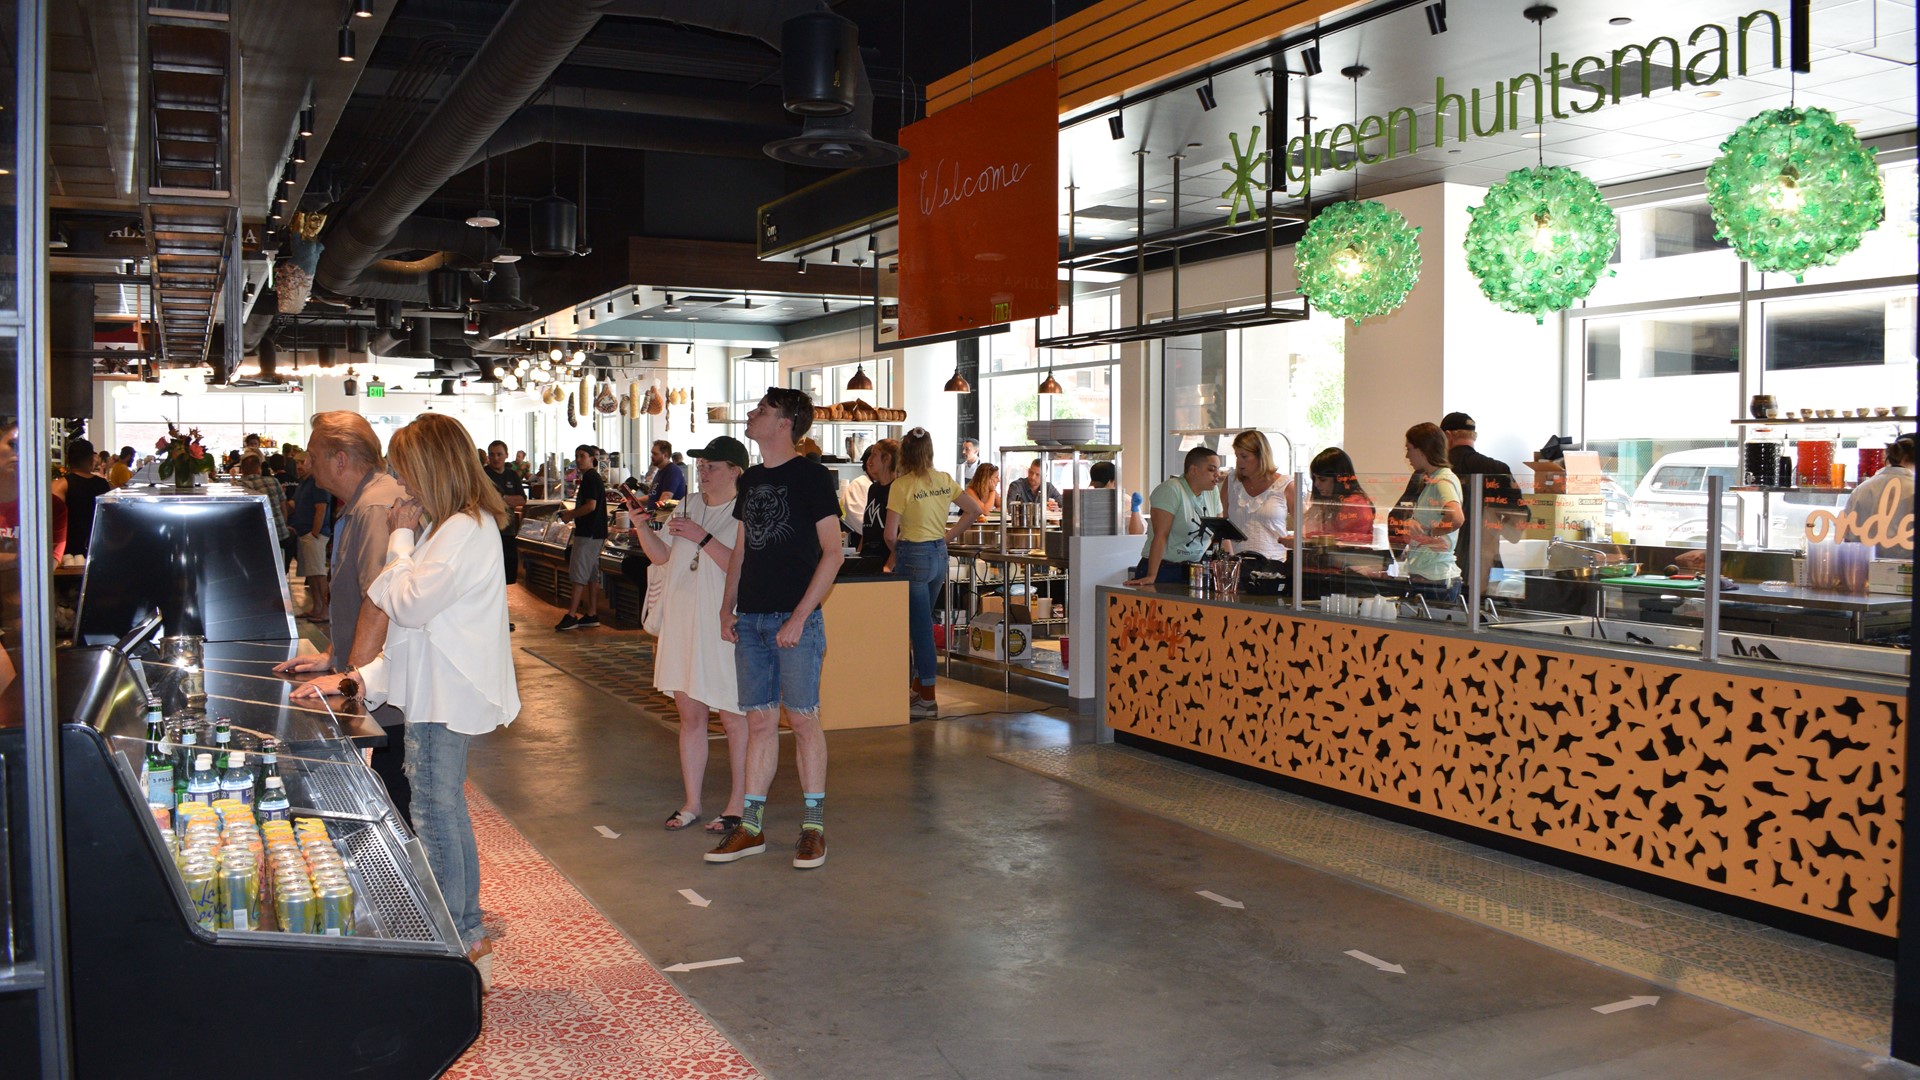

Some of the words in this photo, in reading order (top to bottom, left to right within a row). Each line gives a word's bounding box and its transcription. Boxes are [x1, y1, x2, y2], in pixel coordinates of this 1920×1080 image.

[1285, 106, 1417, 199] green
[1435, 9, 1782, 149] huntsman
[919, 158, 1032, 216] Welcome
[929, 487, 951, 497] Market
